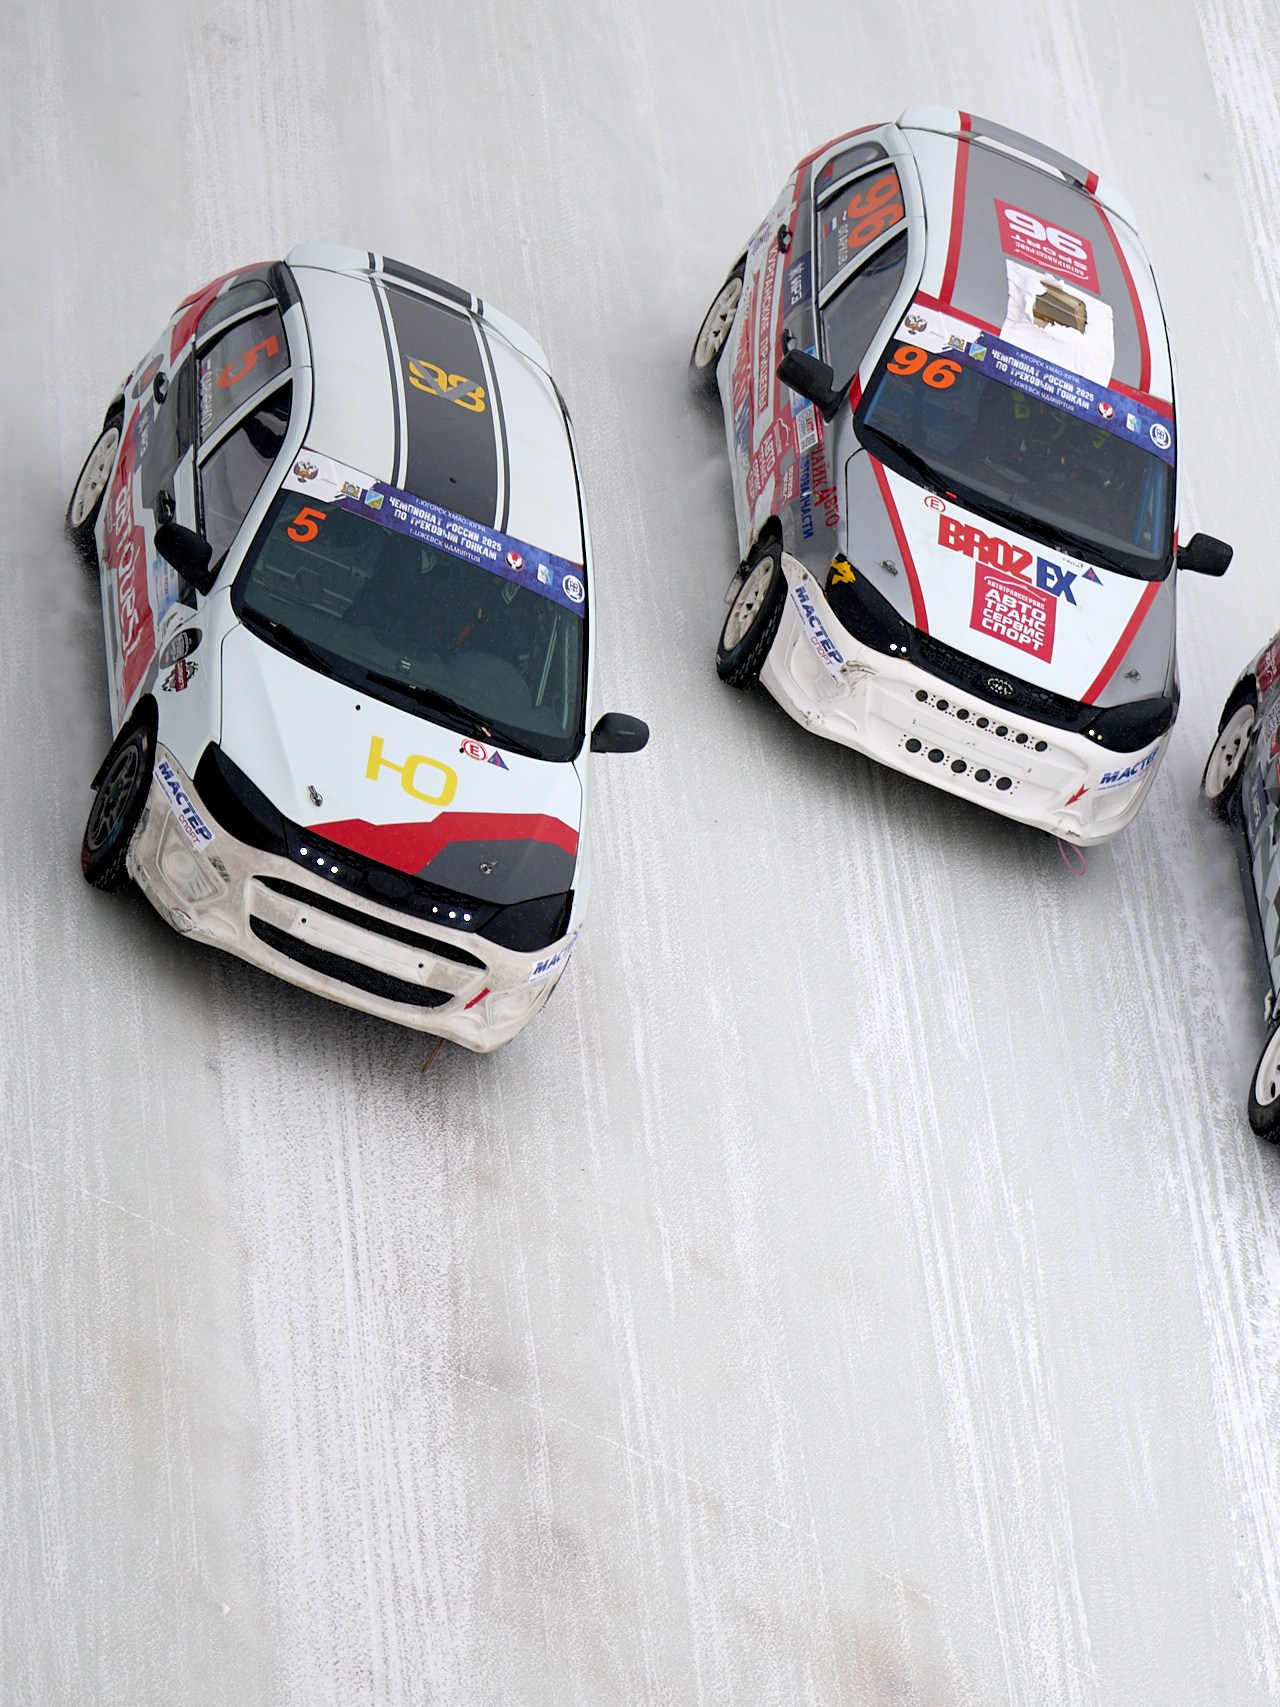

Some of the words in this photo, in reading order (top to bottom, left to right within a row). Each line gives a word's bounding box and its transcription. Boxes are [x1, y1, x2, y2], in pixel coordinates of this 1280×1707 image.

[847, 173, 905, 249] 96
[1004, 209, 1088, 261] 96
[791, 273, 803, 305] ИРЗ
[216, 334, 279, 390] 5
[886, 345, 963, 390] 96
[991, 349, 1041, 377] ЧЕМПИОНАТ
[1043, 372, 1075, 392] РОССИИ
[1075, 386, 1094, 402] 2025
[996, 361, 1009, 372] ПО
[1010, 368, 1054, 394] ТРЕКОВЫМ
[1056, 387, 1090, 409] ГОНКАМ
[287, 506, 327, 543] 5
[389, 496, 443, 527] ЧЕМПИОНАТ
[446, 521, 480, 543] РОССИИ
[481, 535, 502, 552] 2025
[394, 508, 408, 521] ПО
[410, 516, 458, 544] ТРЕКОВЫМ
[460, 536, 498, 561] ГОНКАМ
[795, 586, 844, 666] МАСТЕР
[982, 608, 1045, 640] СЕРВИС
[985, 588, 1046, 622] АВТО
[985, 598, 1046, 633] ТРАНС
[810, 635, 833, 667] СПОРТ
[981, 618, 1044, 651] СПОРТ
[365, 735, 458, 807] Ю
[159, 761, 212, 840] МАСТЕР
[178, 814, 200, 843] СПОРТ
